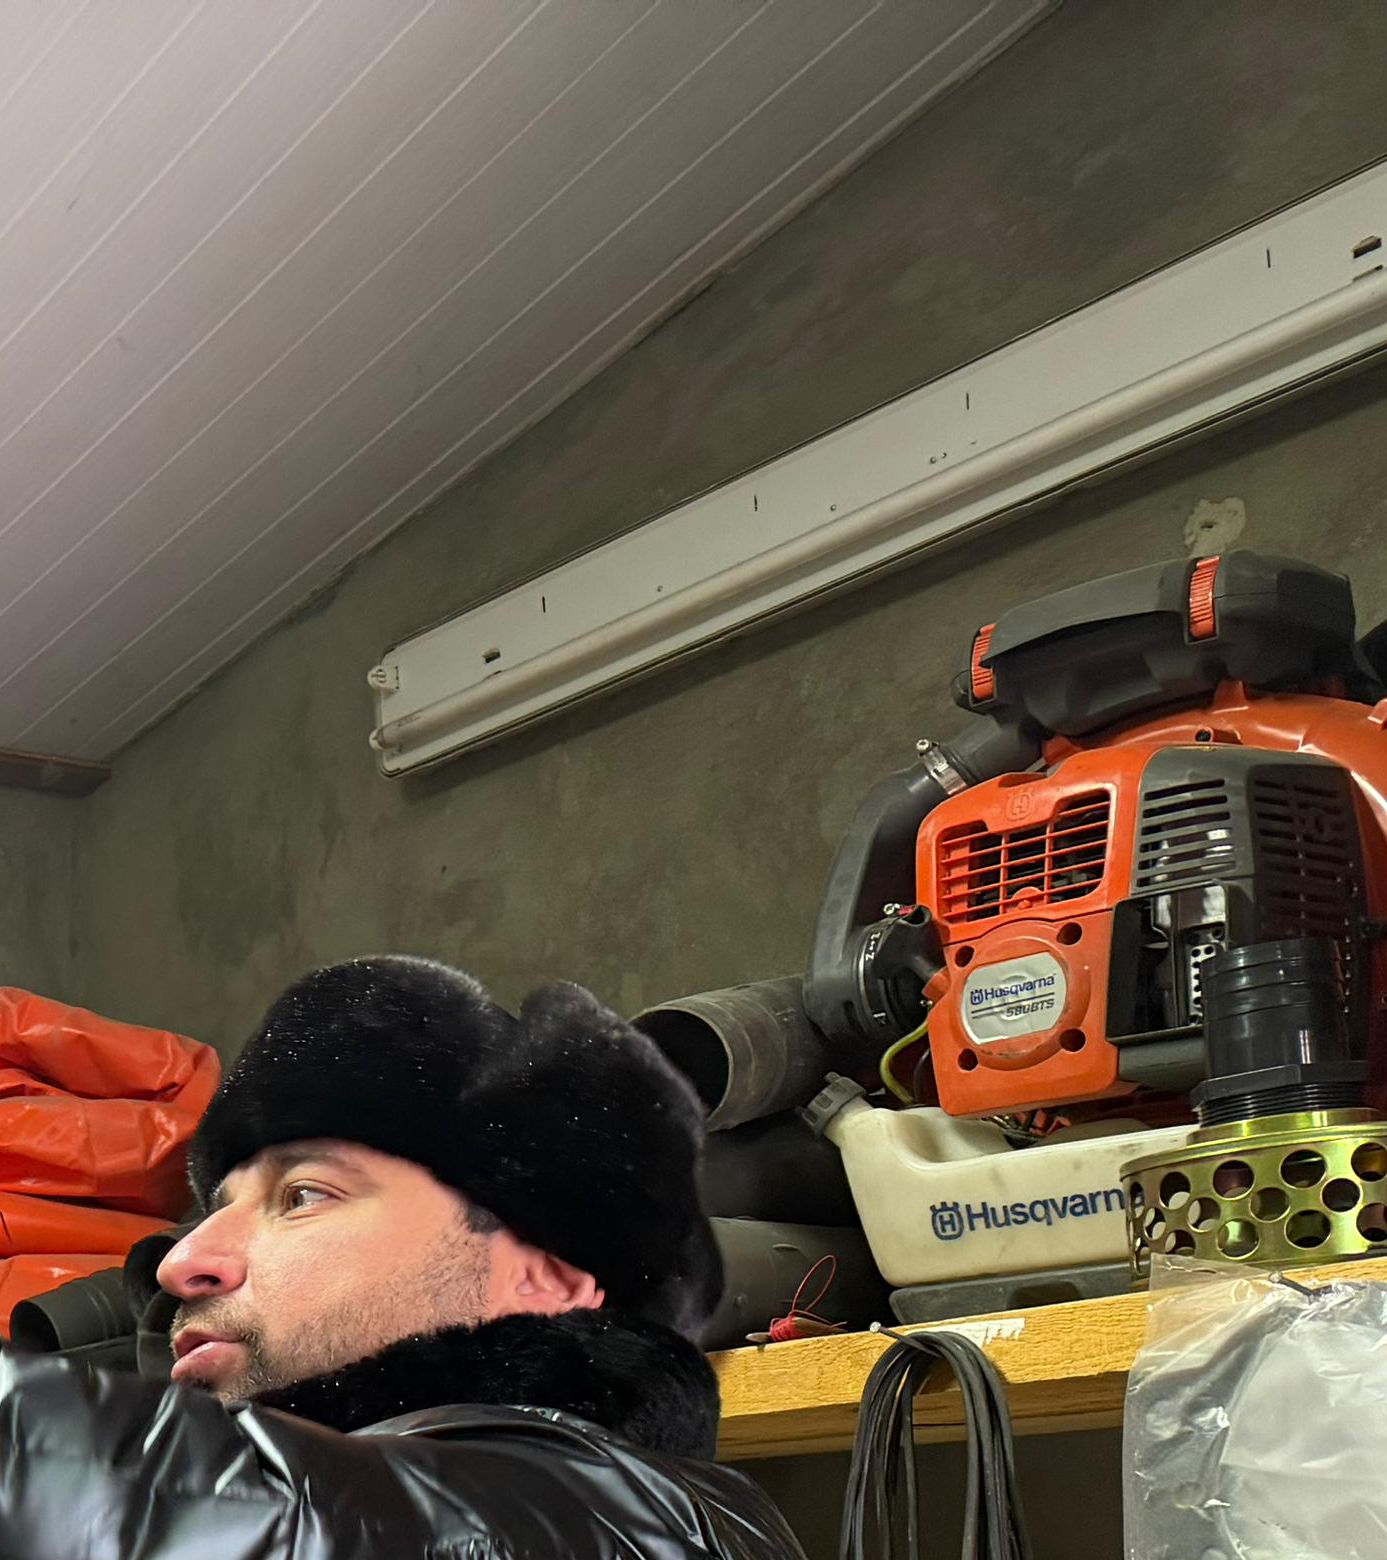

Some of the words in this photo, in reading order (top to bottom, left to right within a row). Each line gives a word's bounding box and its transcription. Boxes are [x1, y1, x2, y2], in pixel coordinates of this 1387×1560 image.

[984, 974, 1055, 1001] Husqvarna
[1005, 998, 1055, 1017] 580BTS
[966, 1187, 1144, 1231] Husqvarn
